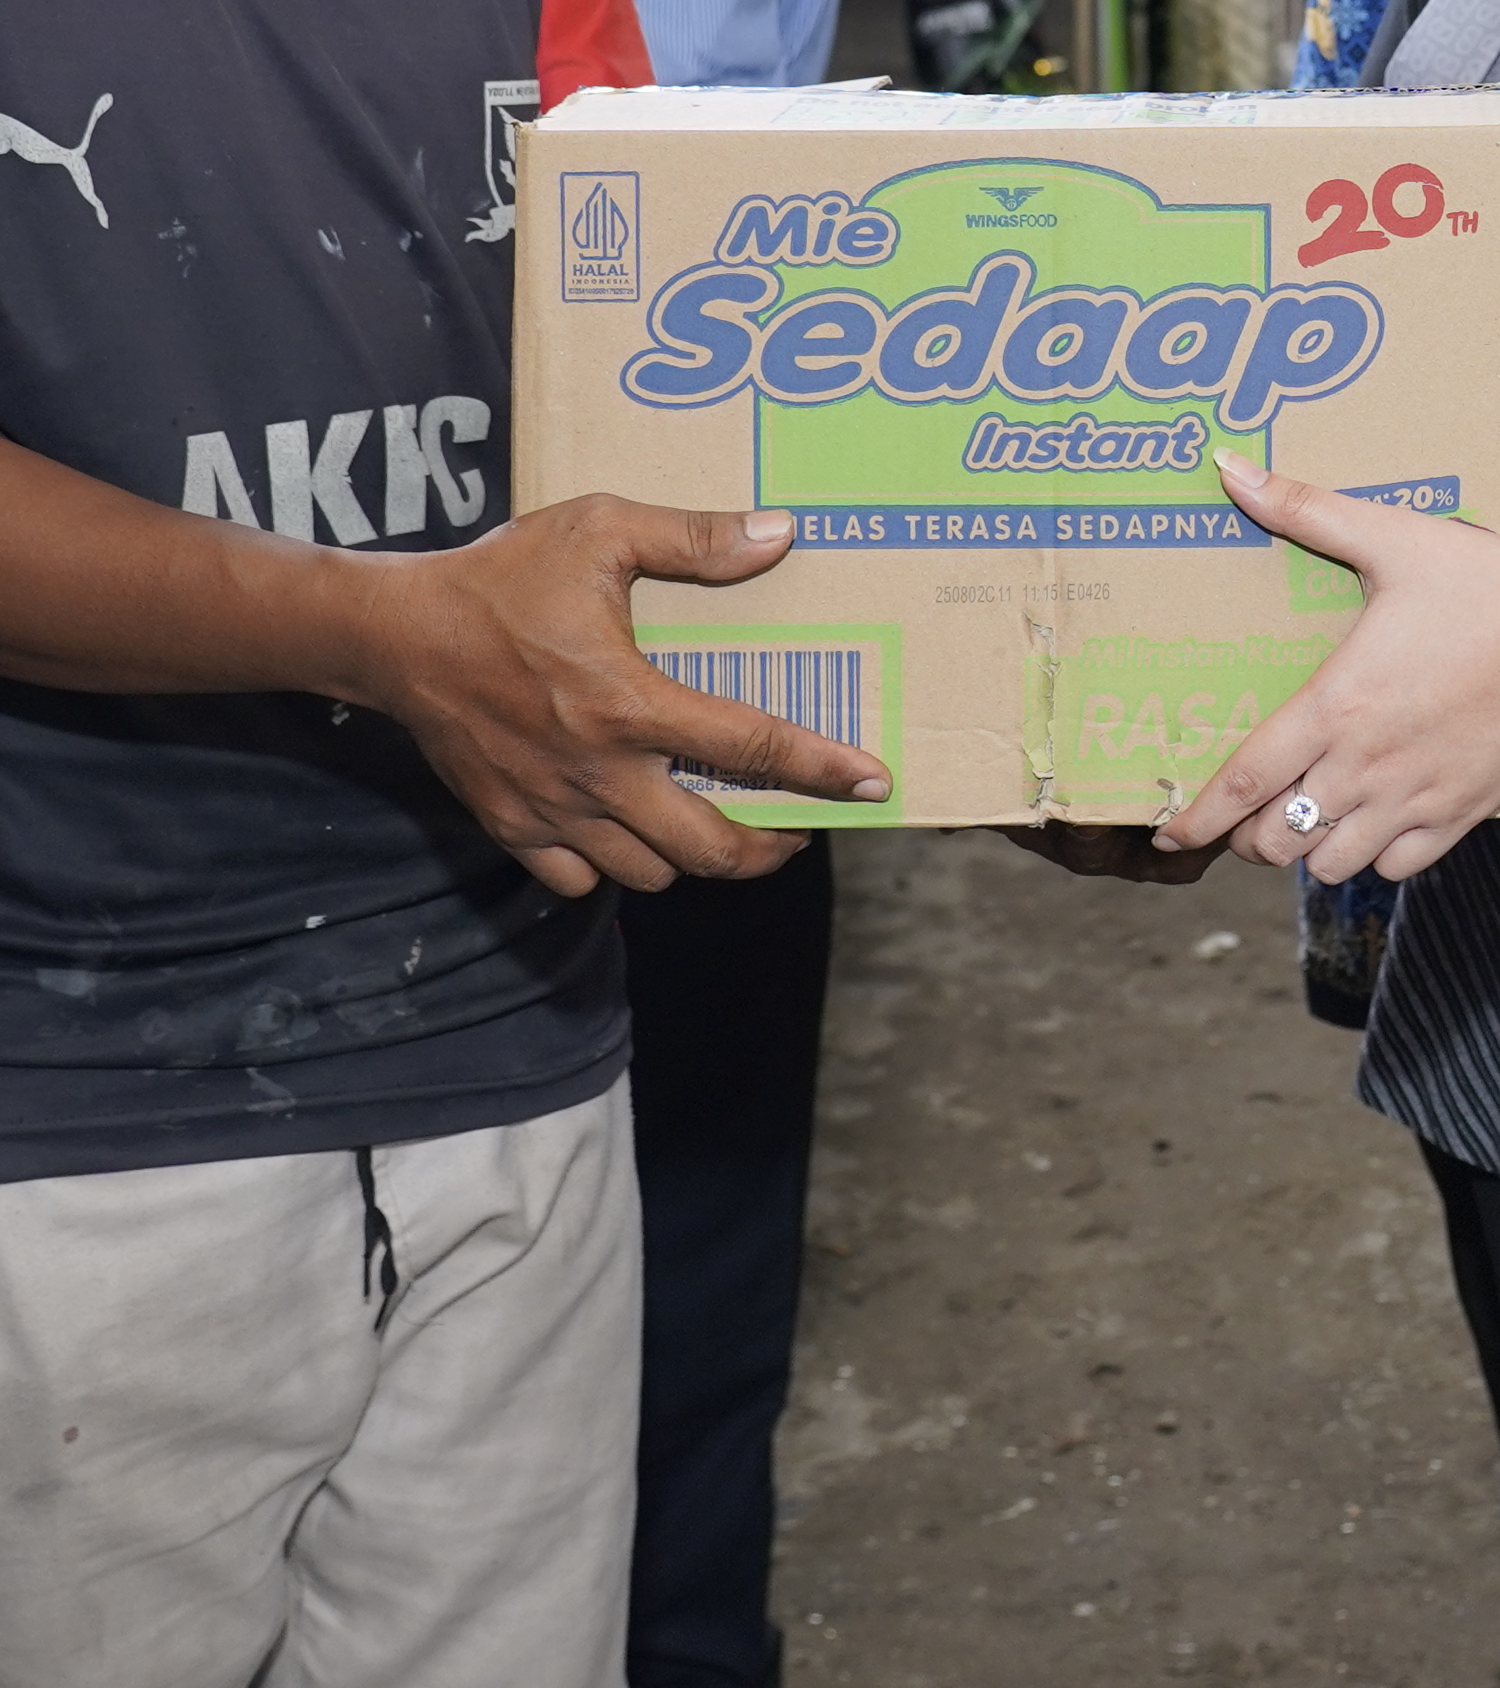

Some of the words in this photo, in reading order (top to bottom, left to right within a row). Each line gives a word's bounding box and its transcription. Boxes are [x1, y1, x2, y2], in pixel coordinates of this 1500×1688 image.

[720, 195, 894, 263] Mie
[965, 214, 1058, 229] WINGSFOOD
[572, 263, 630, 277] HALAL
[623, 252, 1381, 433] Sedaap
[966, 415, 1204, 471] Instant
[905, 514, 1038, 541] TERASA
[1057, 513, 1243, 541] SEDAPNYA
[1067, 583, 1110, 601] E0426
[1134, 638, 1236, 668] Instan
[1076, 690, 1266, 761] RASA
